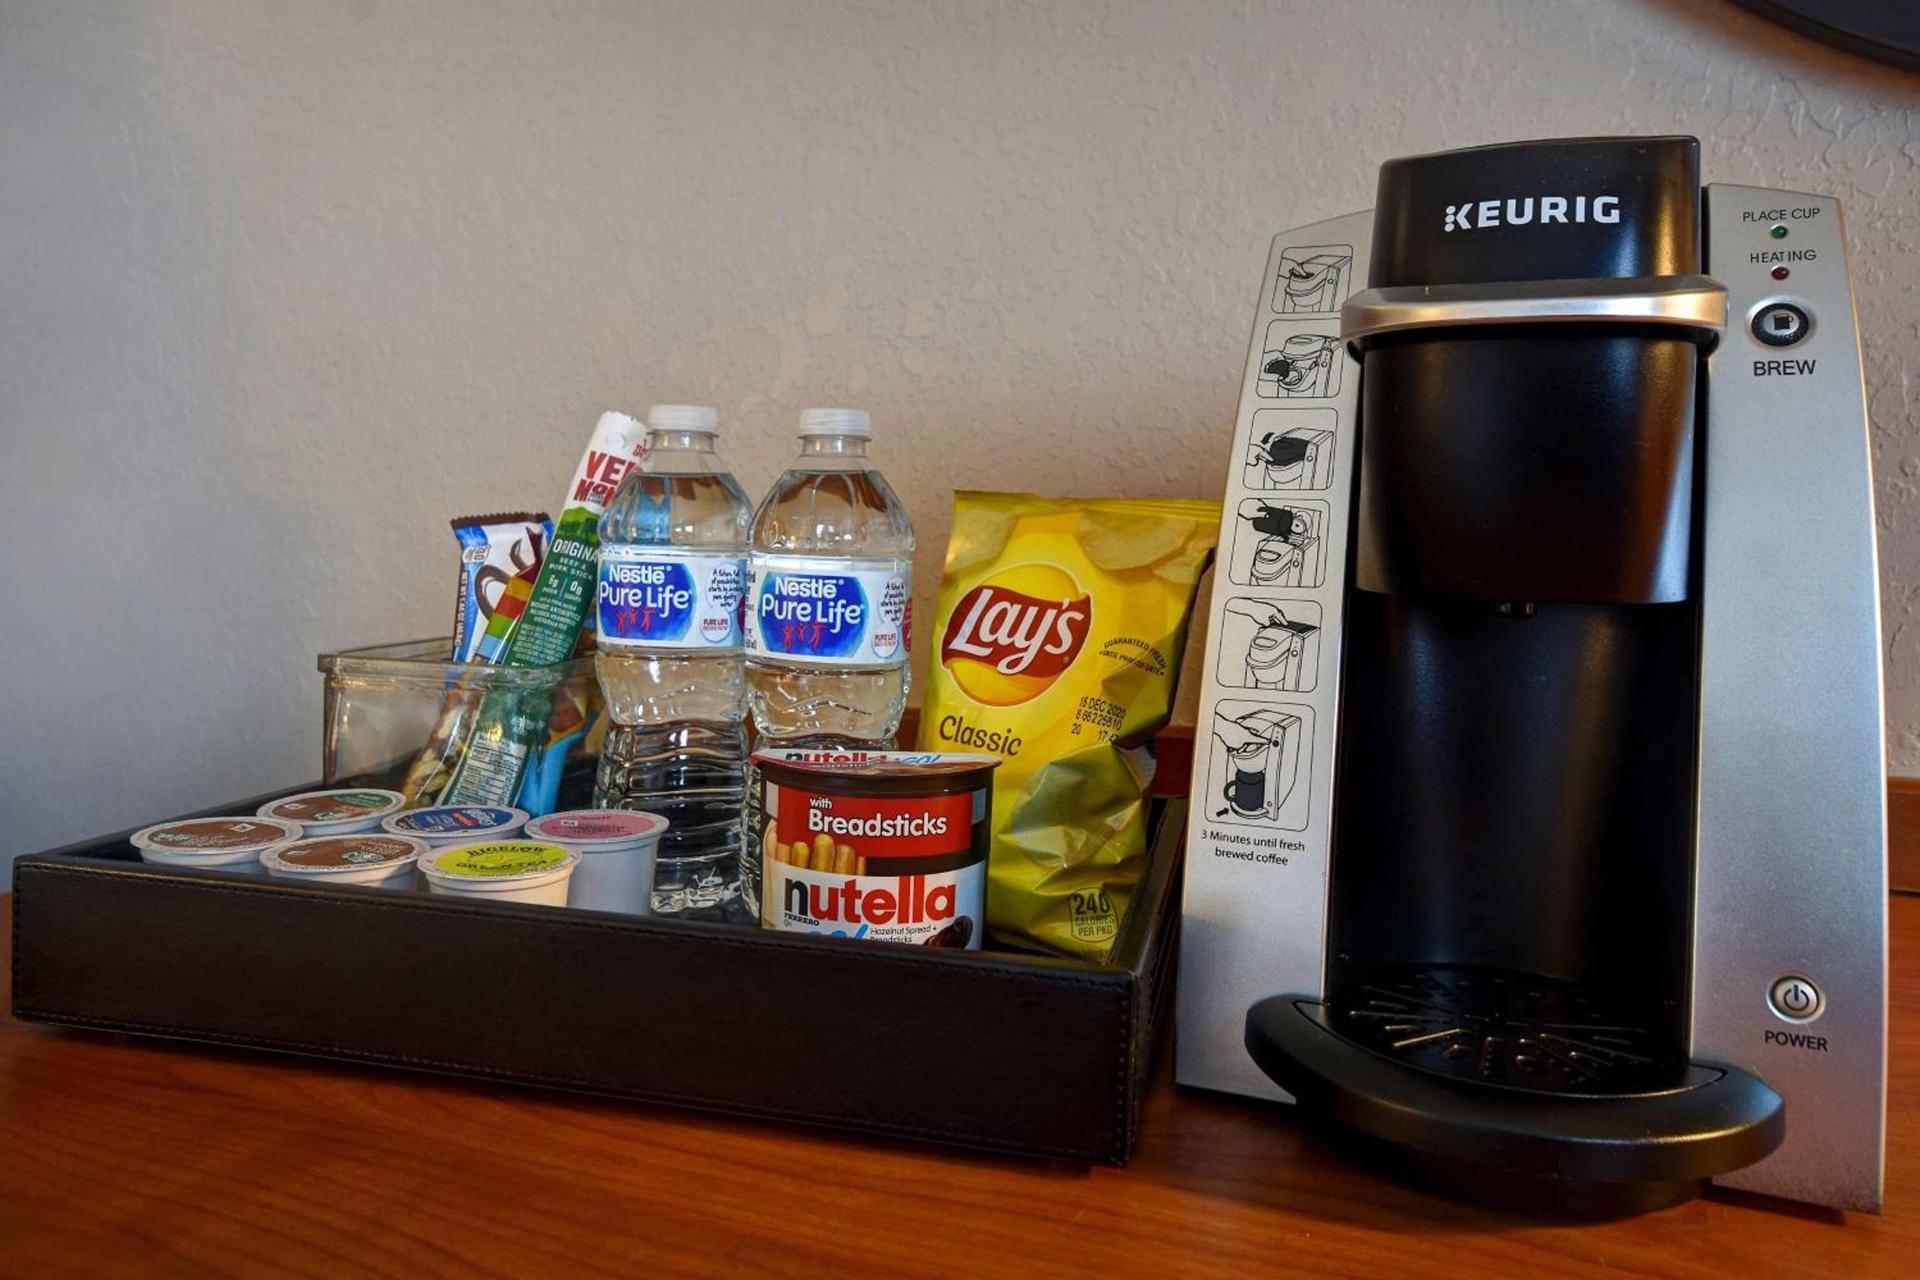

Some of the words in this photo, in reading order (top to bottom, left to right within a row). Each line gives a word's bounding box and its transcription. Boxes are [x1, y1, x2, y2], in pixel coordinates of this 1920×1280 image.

[1444, 195, 1620, 232] KEURIG
[1742, 209, 1787, 222] PLACE
[1791, 207, 1821, 220] CUP
[1750, 249, 1817, 264] HEATING
[1753, 360, 1816, 377] BREW
[553, 538, 600, 564] ORIGINA
[609, 564, 666, 584] Nestlé
[775, 576, 837, 599] Nestlé
[599, 581, 642, 607] Pure
[646, 585, 690, 618] Life
[762, 593, 812, 621] Pure
[816, 599, 861, 633] Life
[948, 588, 1085, 675] Lay's
[1089, 698, 1106, 713] DEC
[939, 715, 1022, 757] Classic
[809, 797, 833, 809] with
[808, 809, 948, 838] Breadsticks
[1201, 829, 1208, 840] 3
[1209, 830, 1251, 846] Minutes
[1253, 838, 1277, 849] until
[1279, 838, 1305, 852] fresh
[1214, 847, 1254, 862] brewed
[1256, 855, 1289, 866] coffee
[784, 874, 957, 925] nutella
[1074, 893, 1110, 915] 240
[871, 927, 905, 936] Hazelnut
[906, 925, 932, 936] Spread
[1078, 926, 1094, 936] PER
[1096, 925, 1113, 936] PKG
[1764, 1030, 1828, 1052] POWER
